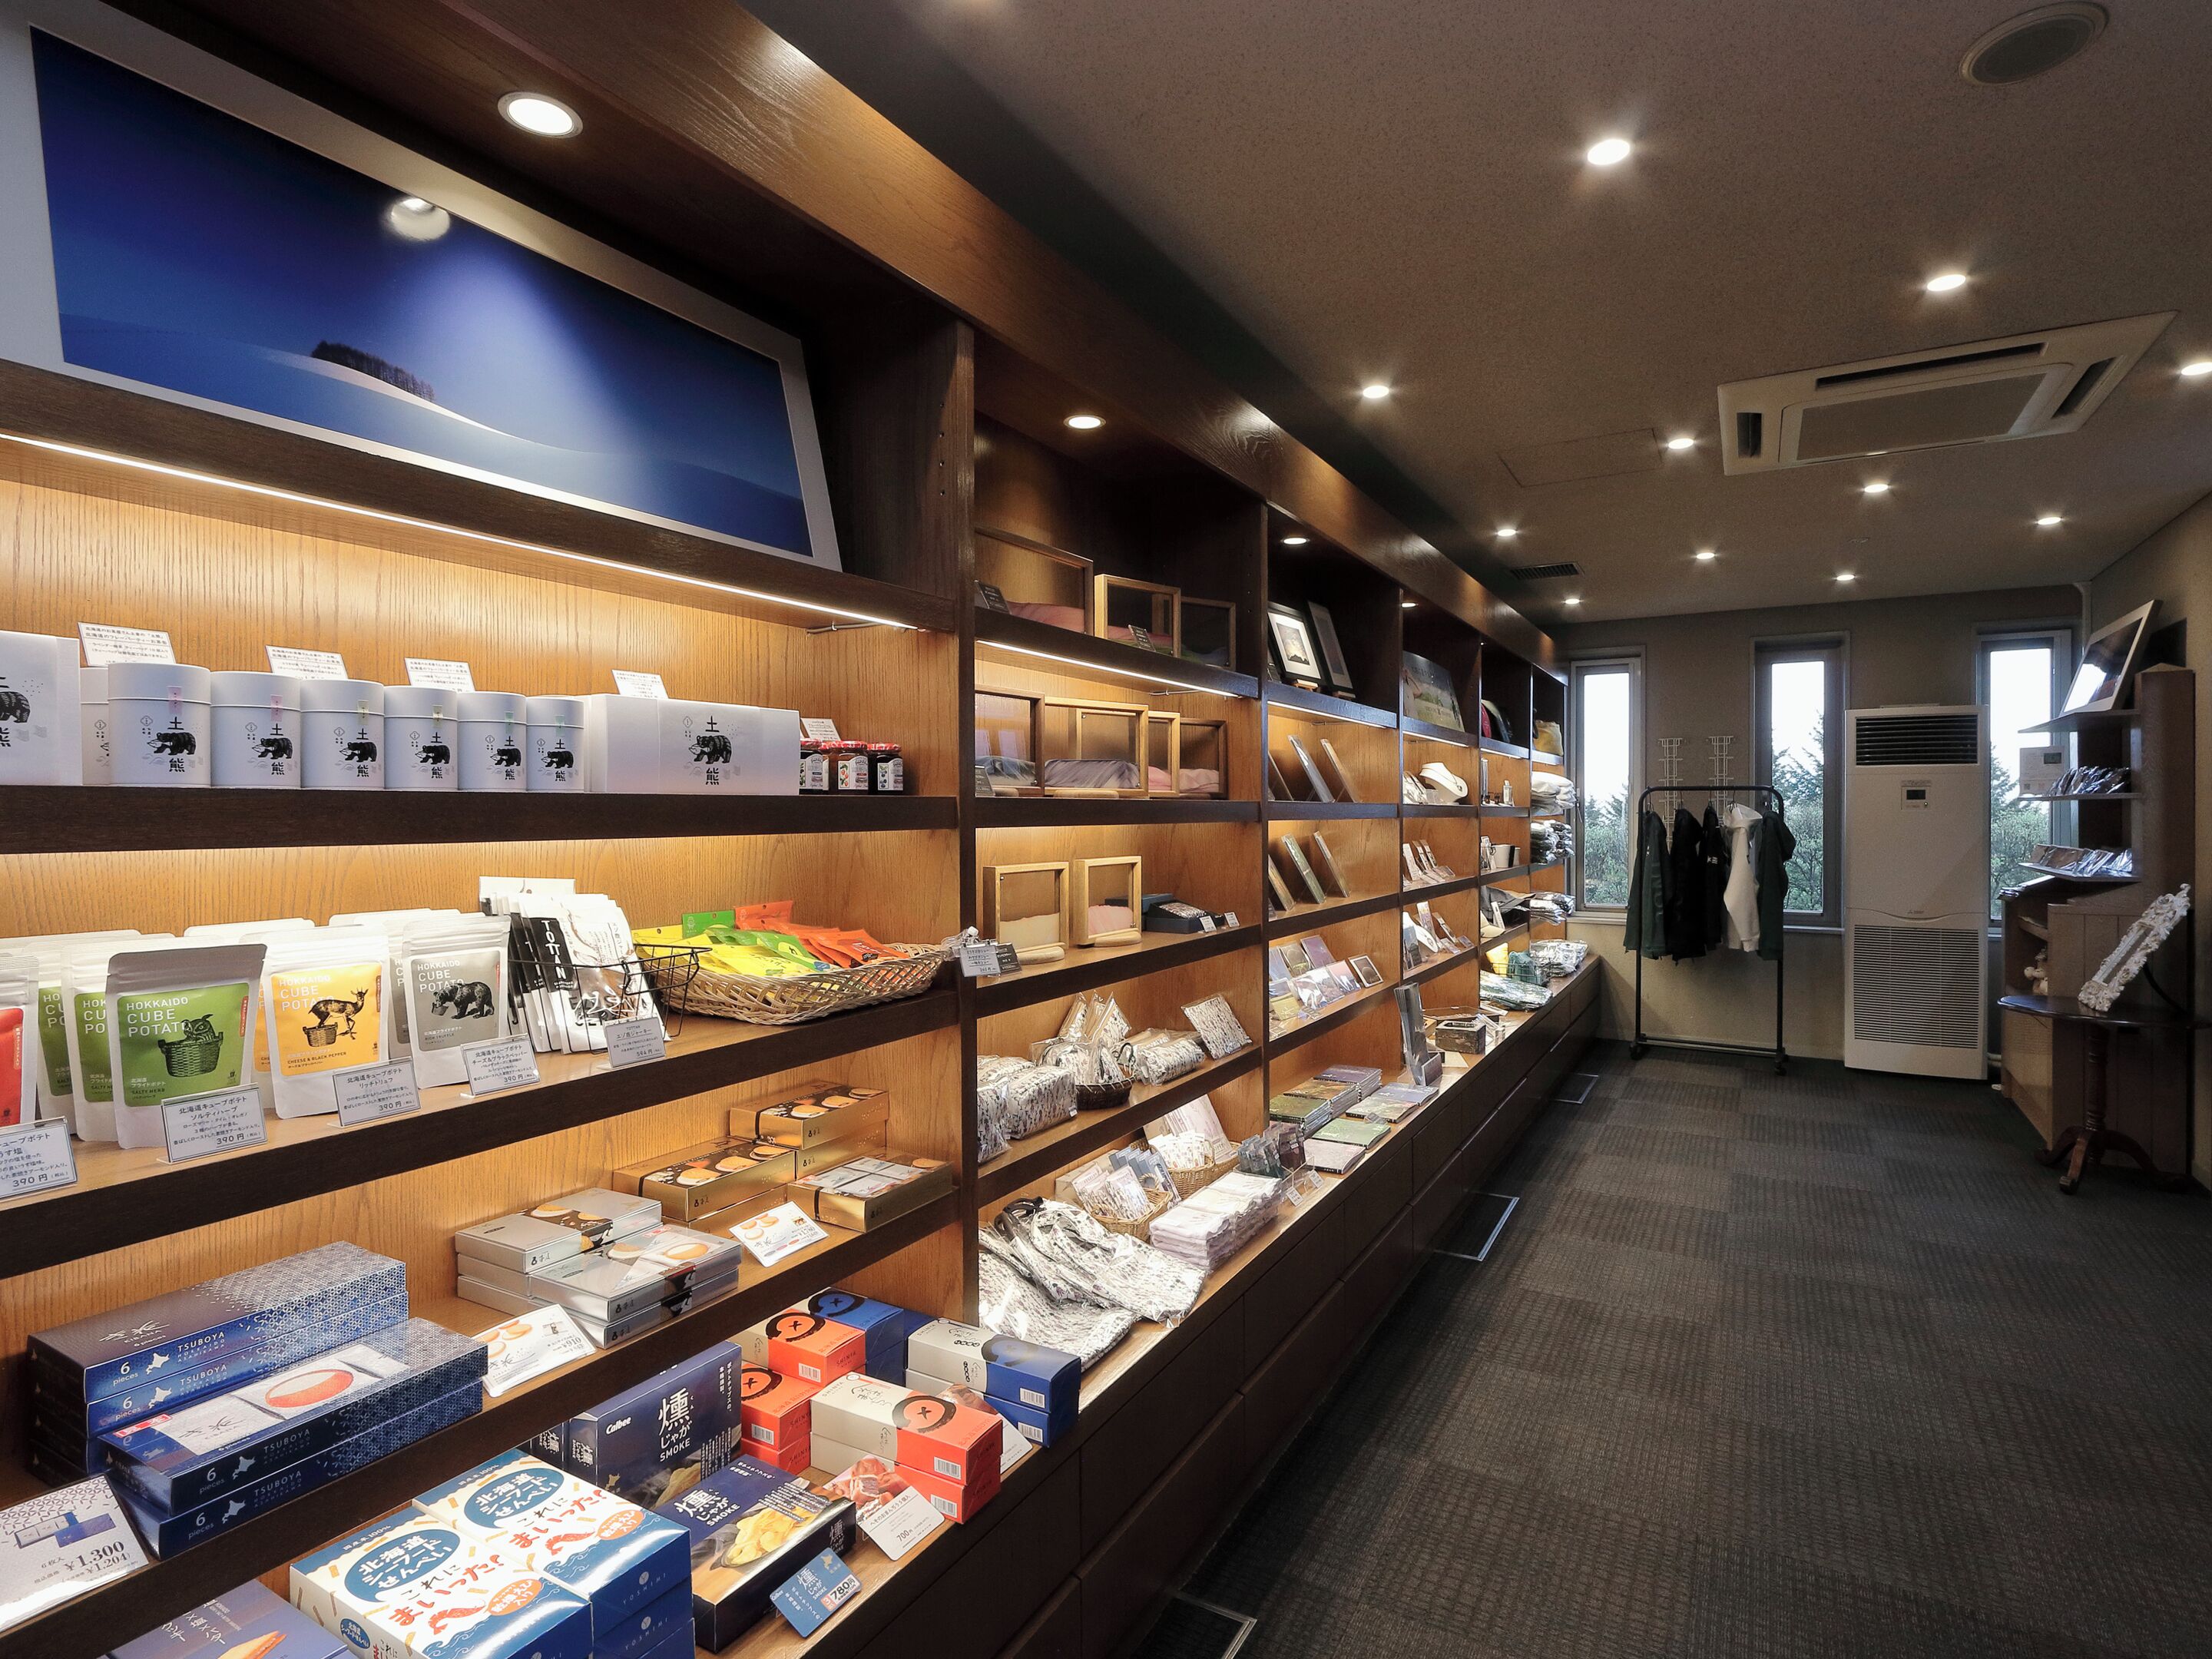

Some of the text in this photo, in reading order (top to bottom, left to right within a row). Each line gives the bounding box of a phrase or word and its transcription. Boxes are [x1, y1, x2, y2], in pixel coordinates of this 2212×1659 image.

[169, 758, 185, 773] 熊
[271, 762, 285, 775] 熊
[356, 765, 369, 777] 熊
[432, 767, 443, 779] 熊
[505, 769, 515, 780] 熊
[555, 770, 566, 781] 熊
[706, 767, 719, 785] 熊
[417, 959, 460, 971] HOKKAIDO
[280, 975, 330, 986] HOKKAIDO
[419, 969, 451, 982] CUBE
[280, 985, 319, 998] CUBE
[126, 997, 188, 1011] HOKKAIDO
[127, 1008, 176, 1024] CUBE
[179, 1096, 247, 1114] 北海道キューブポテト
[0, 1133, 50, 1147] ューブポテト
[177, 1331, 224, 1353] TSUBOYA
[120, 1362, 131, 1375] 6
[180, 1364, 227, 1386] TSUBOYA
[113, 1371, 139, 1386] pieces
[123, 1396, 133, 1409] 6
[116, 1407, 141, 1421] pieces
[605, 1417, 632, 1435] Calbee
[263, 1429, 310, 1453] TSUBOYA
[661, 1420, 693, 1449] じゃが
[660, 1439, 690, 1462] SMOKE
[207, 1468, 217, 1482] 6
[199, 1479, 225, 1495] pieces
[254, 1471, 302, 1496] TSUBOYA
[475, 1472, 535, 1506] 北海道
[479, 1475, 548, 1515] シーフード
[495, 1482, 558, 1518] せんべい
[196, 1512, 206, 1526] 6
[707, 1504, 740, 1527] SMOKE
[188, 1522, 214, 1540] pieces
[359, 1535, 428, 1575] 北海道
[362, 1538, 442, 1586] シーフード
[378, 1546, 452, 1588] せんべい
[401, 1565, 461, 1601] これに
[623, 1573, 666, 1604] YOSHIMI
[812, 1586, 828, 1601] SMOKE
[625, 1618, 667, 1651] YOSHIMI
